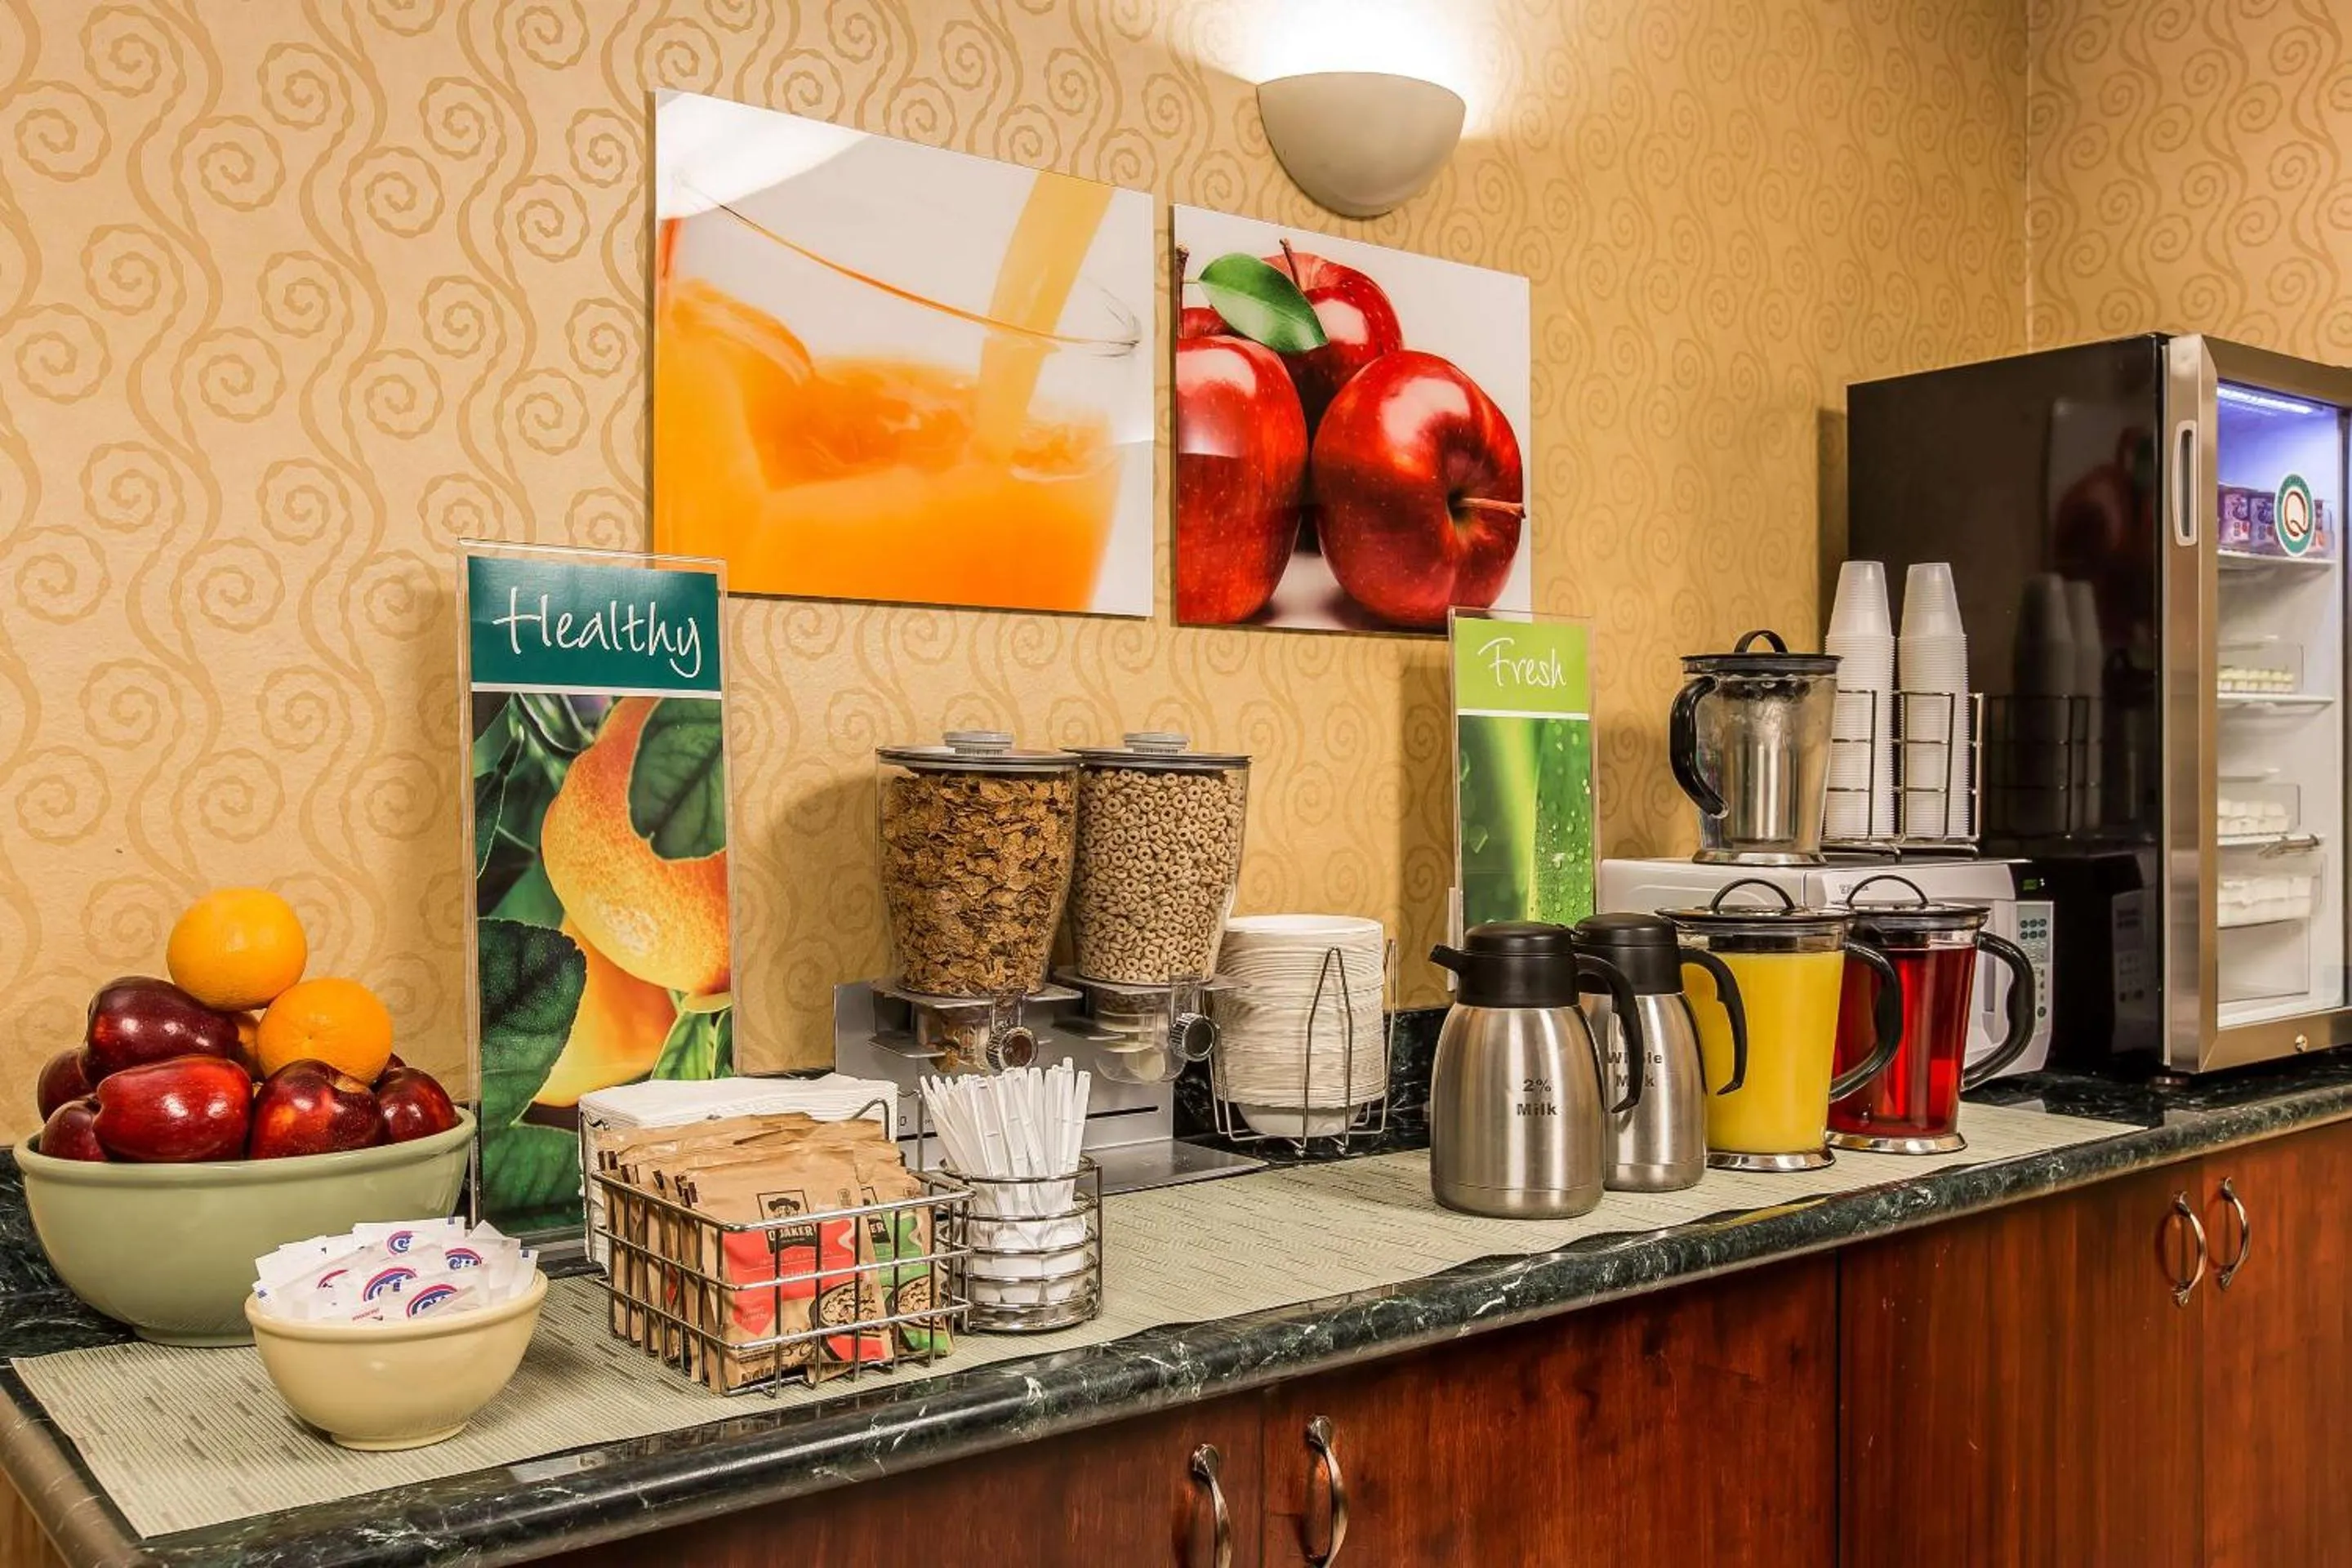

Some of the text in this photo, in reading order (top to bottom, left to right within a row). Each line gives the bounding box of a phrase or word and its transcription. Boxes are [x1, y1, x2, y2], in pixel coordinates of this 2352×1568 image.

[2284, 491, 2309, 537] Q
[492, 586, 702, 678] Healthy
[1477, 637, 1567, 689] Fresh
[1607, 1051, 1663, 1064] Wle
[1522, 1078, 1552, 1093] 2%
[1616, 1074, 1655, 1088] Mk
[1517, 1102, 1557, 1116] Milk
